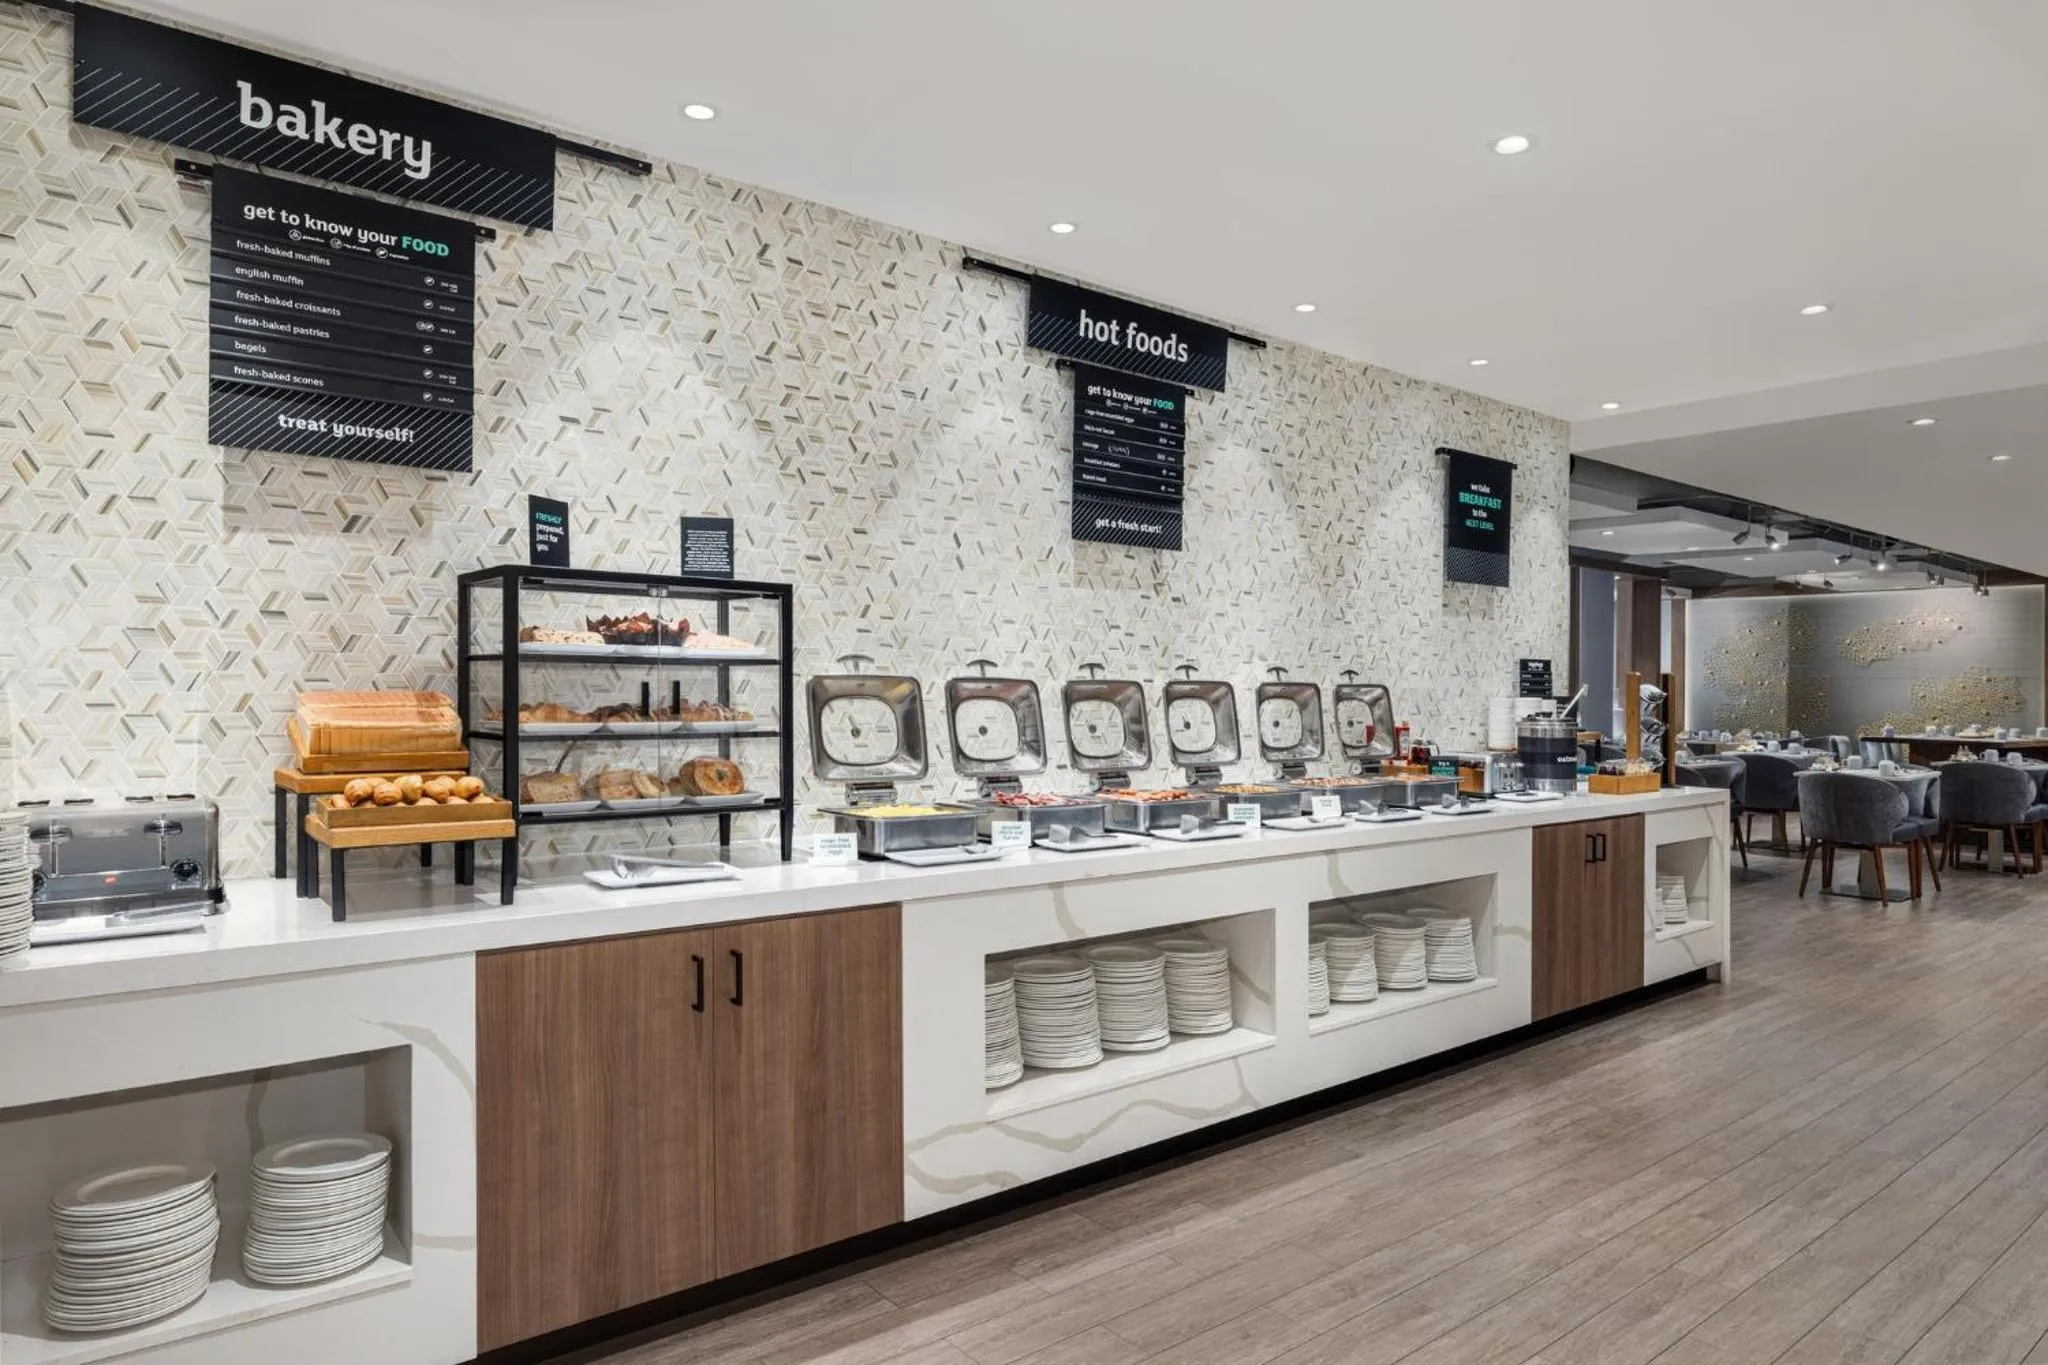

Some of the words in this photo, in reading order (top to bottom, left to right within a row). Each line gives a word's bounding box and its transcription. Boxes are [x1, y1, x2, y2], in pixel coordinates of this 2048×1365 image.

[237, 79, 432, 180] bakery
[243, 204, 276, 221] get
[279, 209, 300, 226] to
[304, 213, 353, 237] know
[357, 228, 398, 246] your
[401, 235, 450, 257] FOOD
[236, 239, 293, 258] fresh-baked
[294, 252, 331, 266] muffins
[235, 266, 270, 279] english
[272, 273, 304, 287] muffin
[236, 289, 293, 309] fresh-baked
[294, 301, 341, 316] croissants
[234, 314, 292, 333] fresh-baked
[292, 325, 330, 338] pastries
[1079, 308, 1120, 346] hot
[1126, 321, 1188, 363] foods
[234, 340, 267, 353] bagels
[233, 365, 291, 383] fresh-baked
[291, 375, 325, 387] scones
[1087, 384, 1102, 396] get
[1102, 387, 1112, 397] to
[1112, 388, 1134, 402] know
[1134, 395, 1152, 406] your
[1153, 398, 1175, 411] FOOD
[277, 413, 328, 433] treat
[332, 420, 415, 443] yourself!
[1458, 491, 1502, 510] BREAKFAST
[1095, 518, 1109, 529] get
[1116, 519, 1139, 531] fresh
